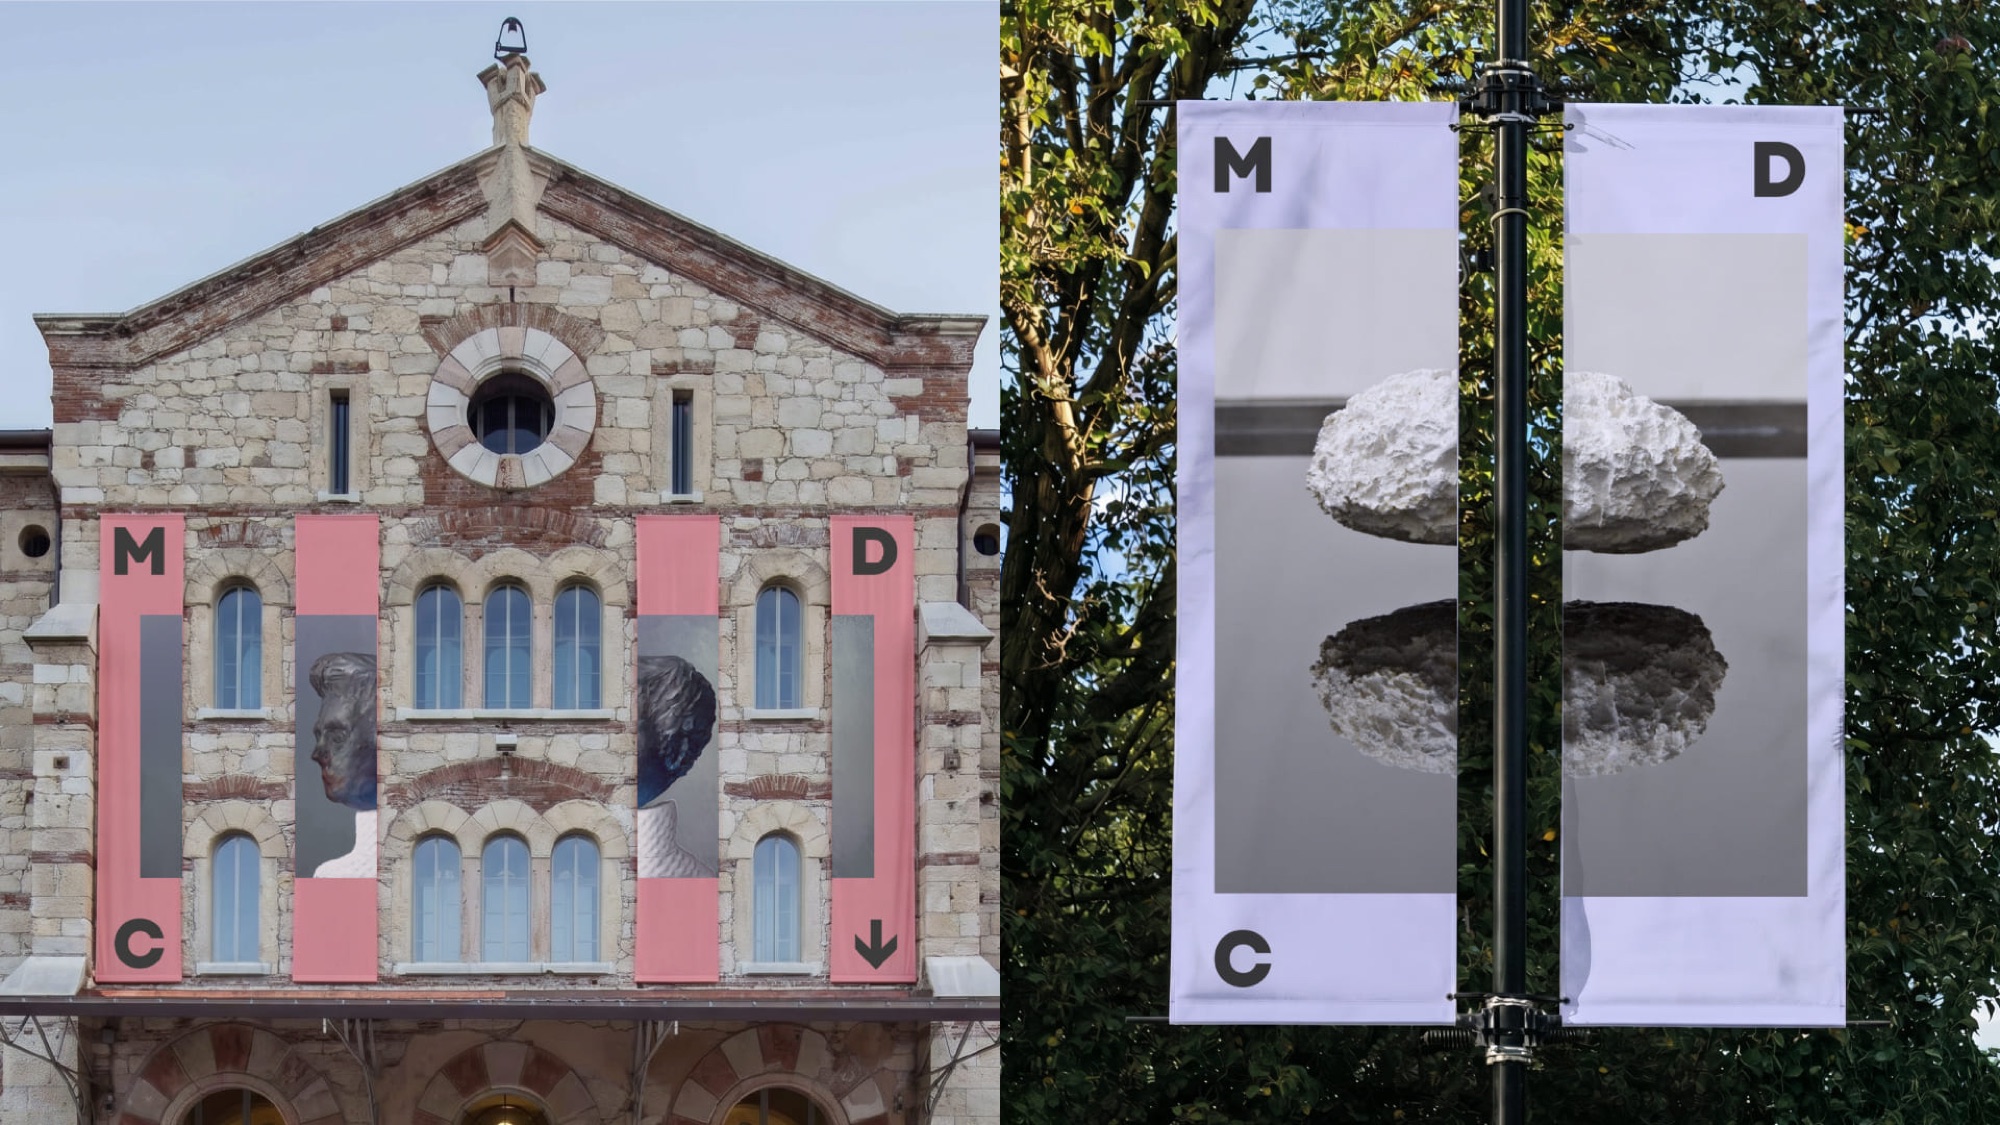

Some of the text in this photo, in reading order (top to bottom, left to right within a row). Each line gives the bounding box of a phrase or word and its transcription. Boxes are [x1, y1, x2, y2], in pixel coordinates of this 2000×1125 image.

[1214, 136, 1272, 193] M
[1754, 141, 1806, 198] D
[113, 526, 166, 576] M
[852, 526, 898, 576] D
[113, 917, 165, 970] C
[1214, 929, 1272, 988] C
